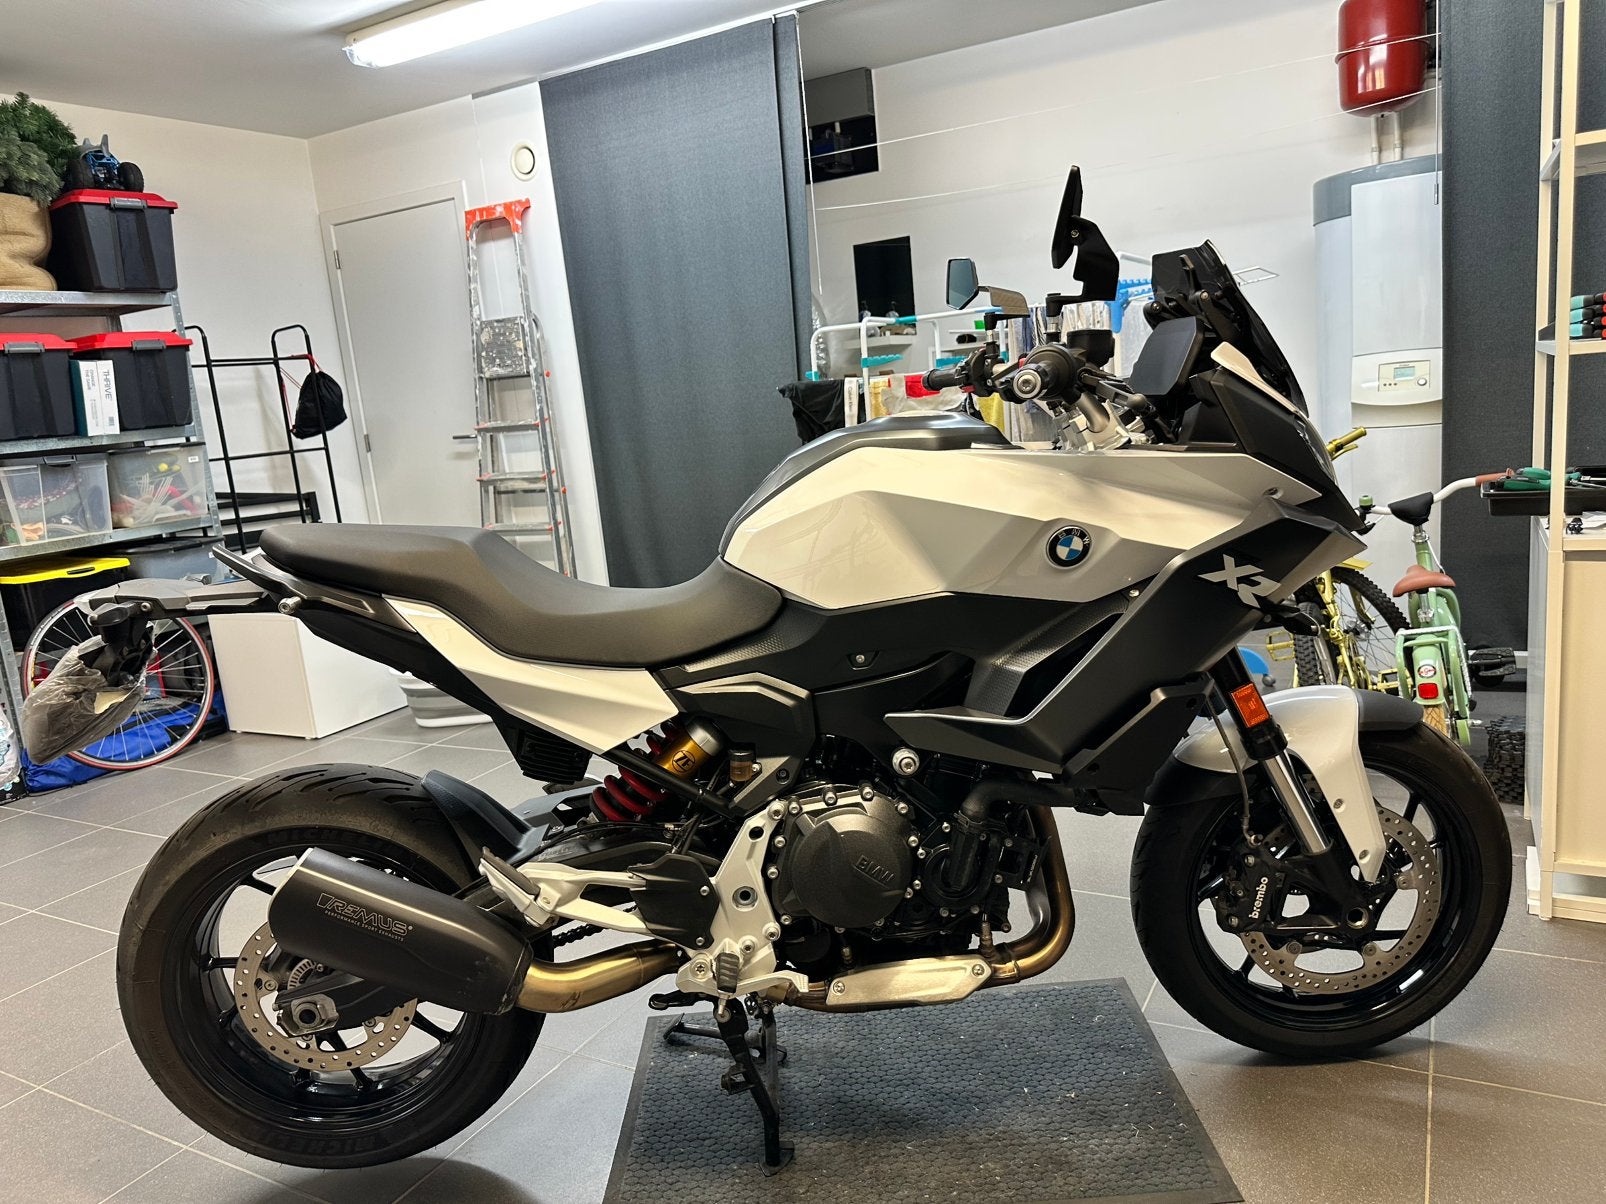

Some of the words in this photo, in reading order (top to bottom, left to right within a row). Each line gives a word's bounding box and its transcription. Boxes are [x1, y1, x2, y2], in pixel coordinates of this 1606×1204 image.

[103, 369, 113, 400] THRIVE
[1058, 528, 1090, 546] BMW
[1197, 553, 1282, 609] XR
[856, 855, 894, 882] BMW
[1248, 877, 1269, 919] brembo
[324, 909, 360, 926] PERFORMANCE
[361, 923, 378, 932] SPORT
[378, 929, 404, 942] EXHAUSTS
[325, 897, 408, 936] REMUS
